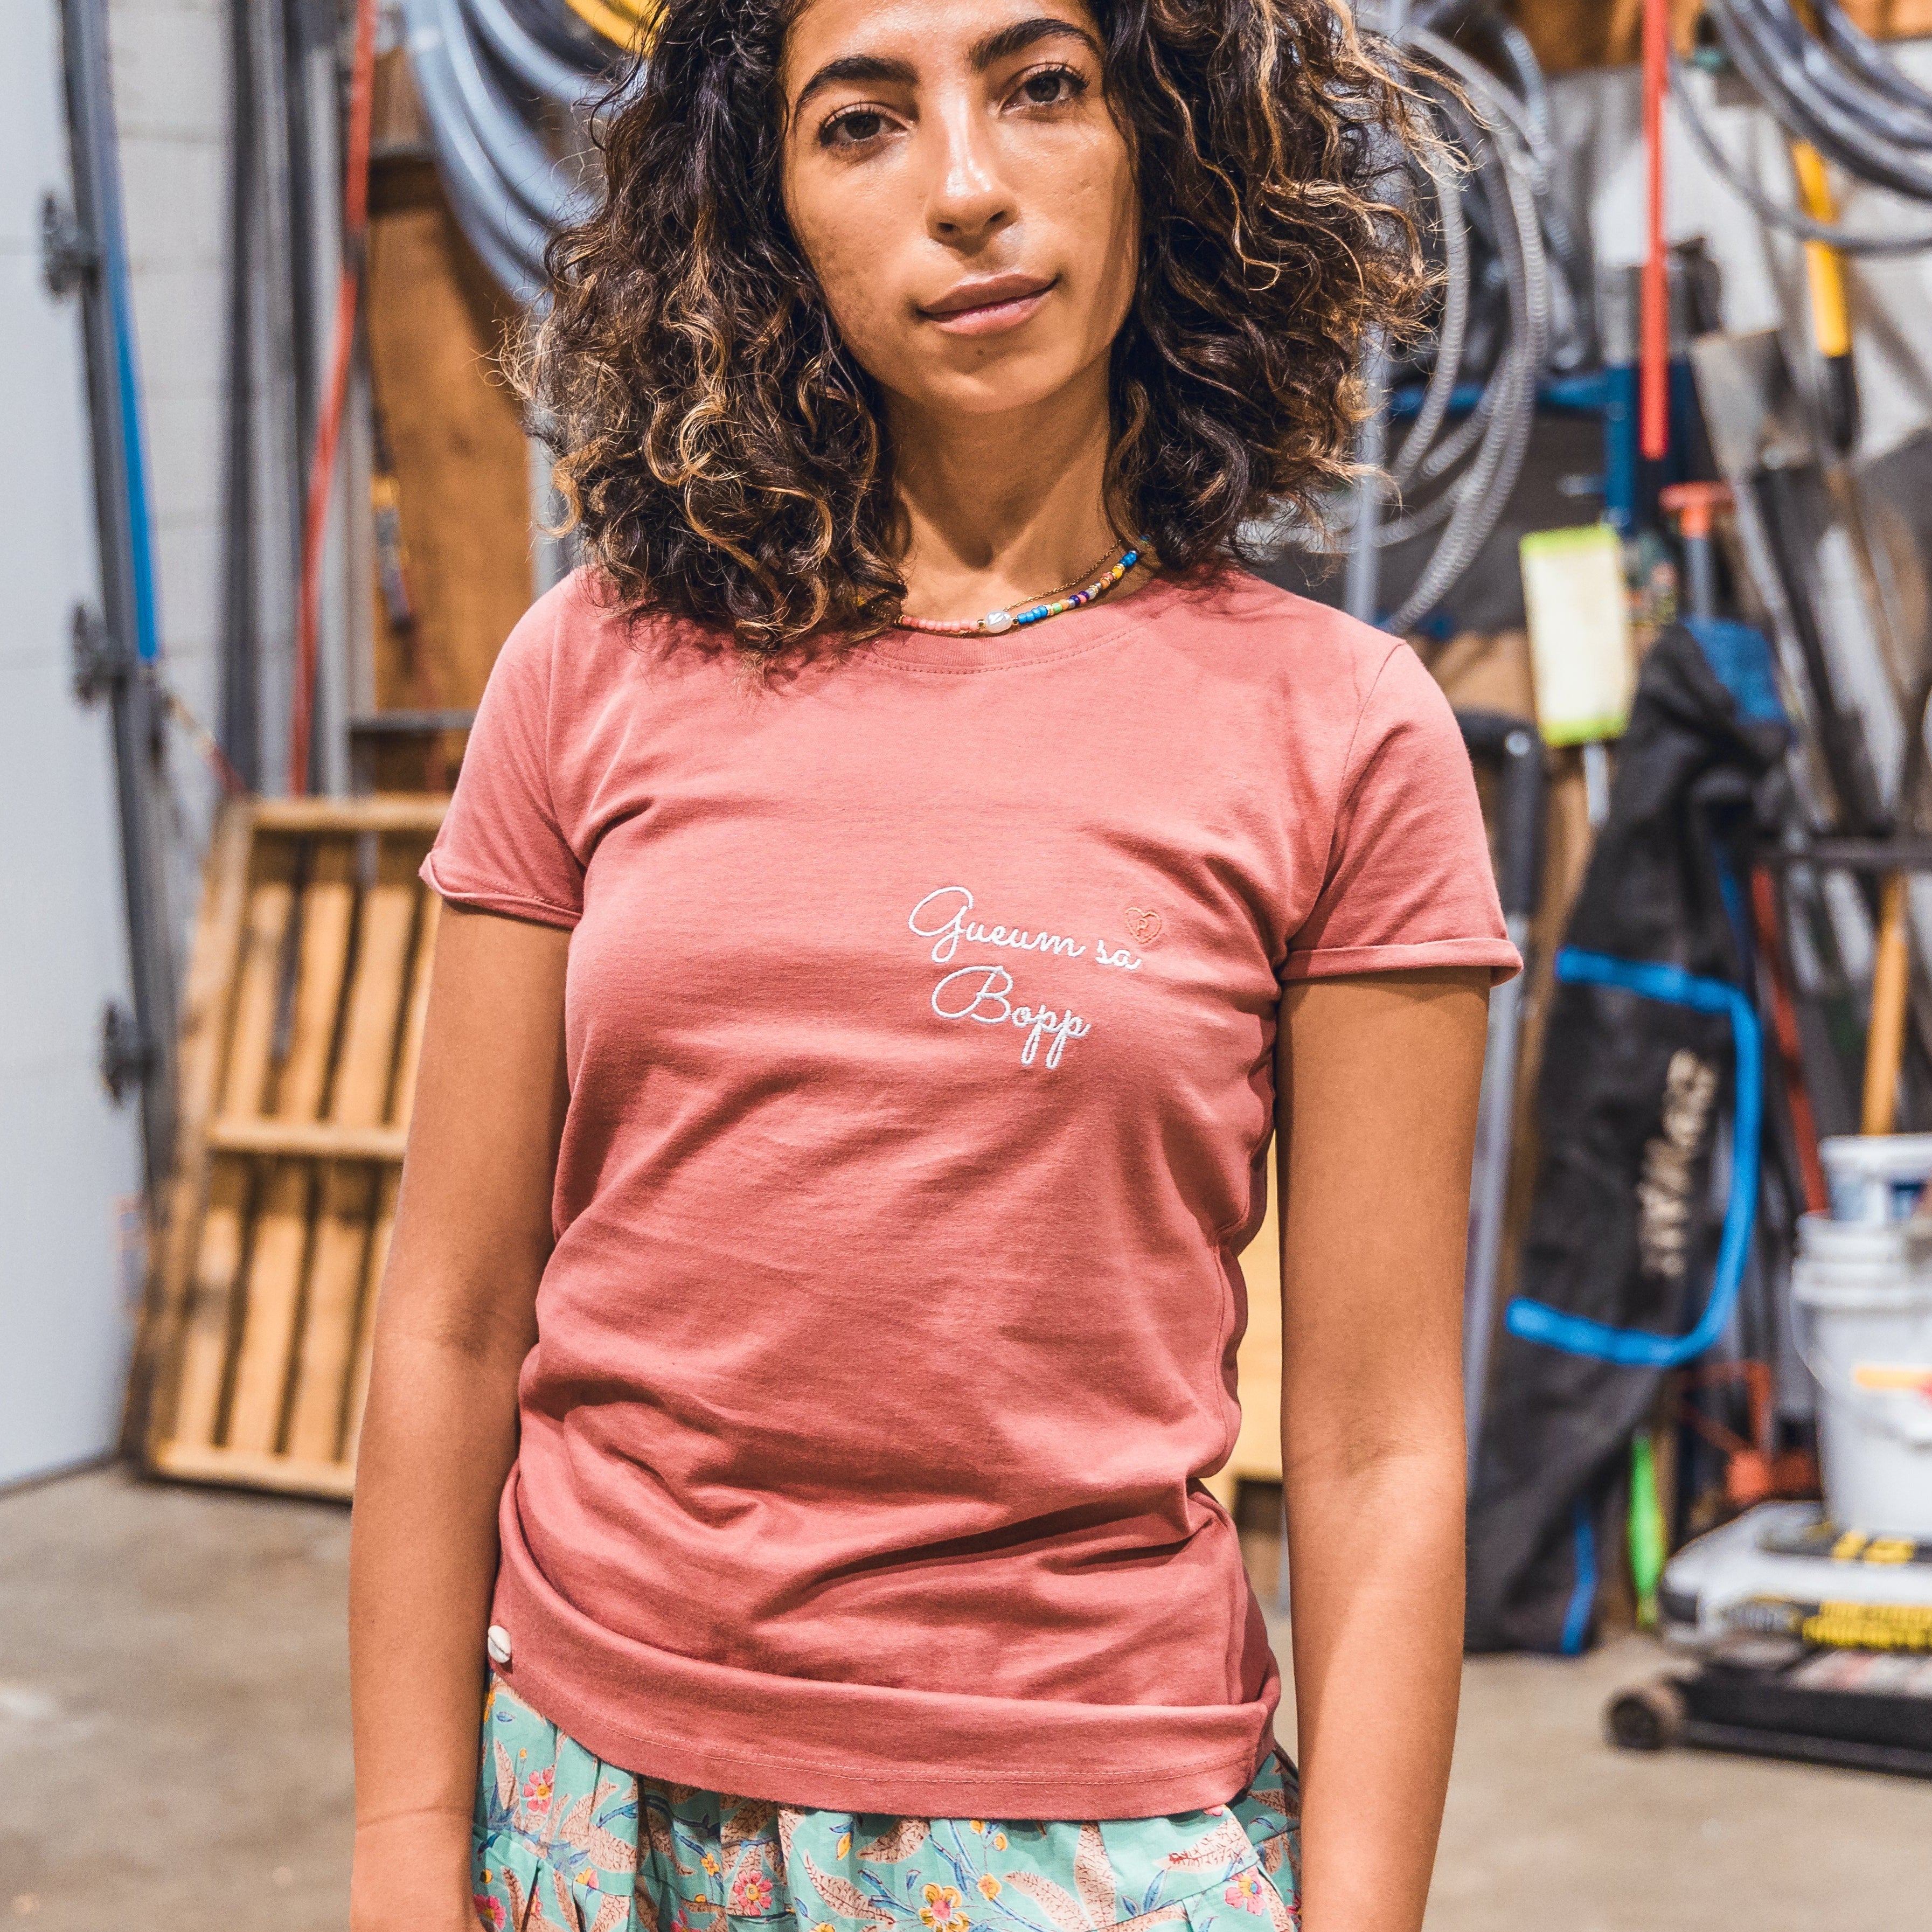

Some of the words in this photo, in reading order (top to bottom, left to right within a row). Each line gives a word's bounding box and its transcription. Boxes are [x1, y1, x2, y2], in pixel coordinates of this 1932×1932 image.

[908, 886, 1086, 963] Gueum
[1095, 939, 1142, 970] sa
[931, 965, 1092, 1069] Bopp
